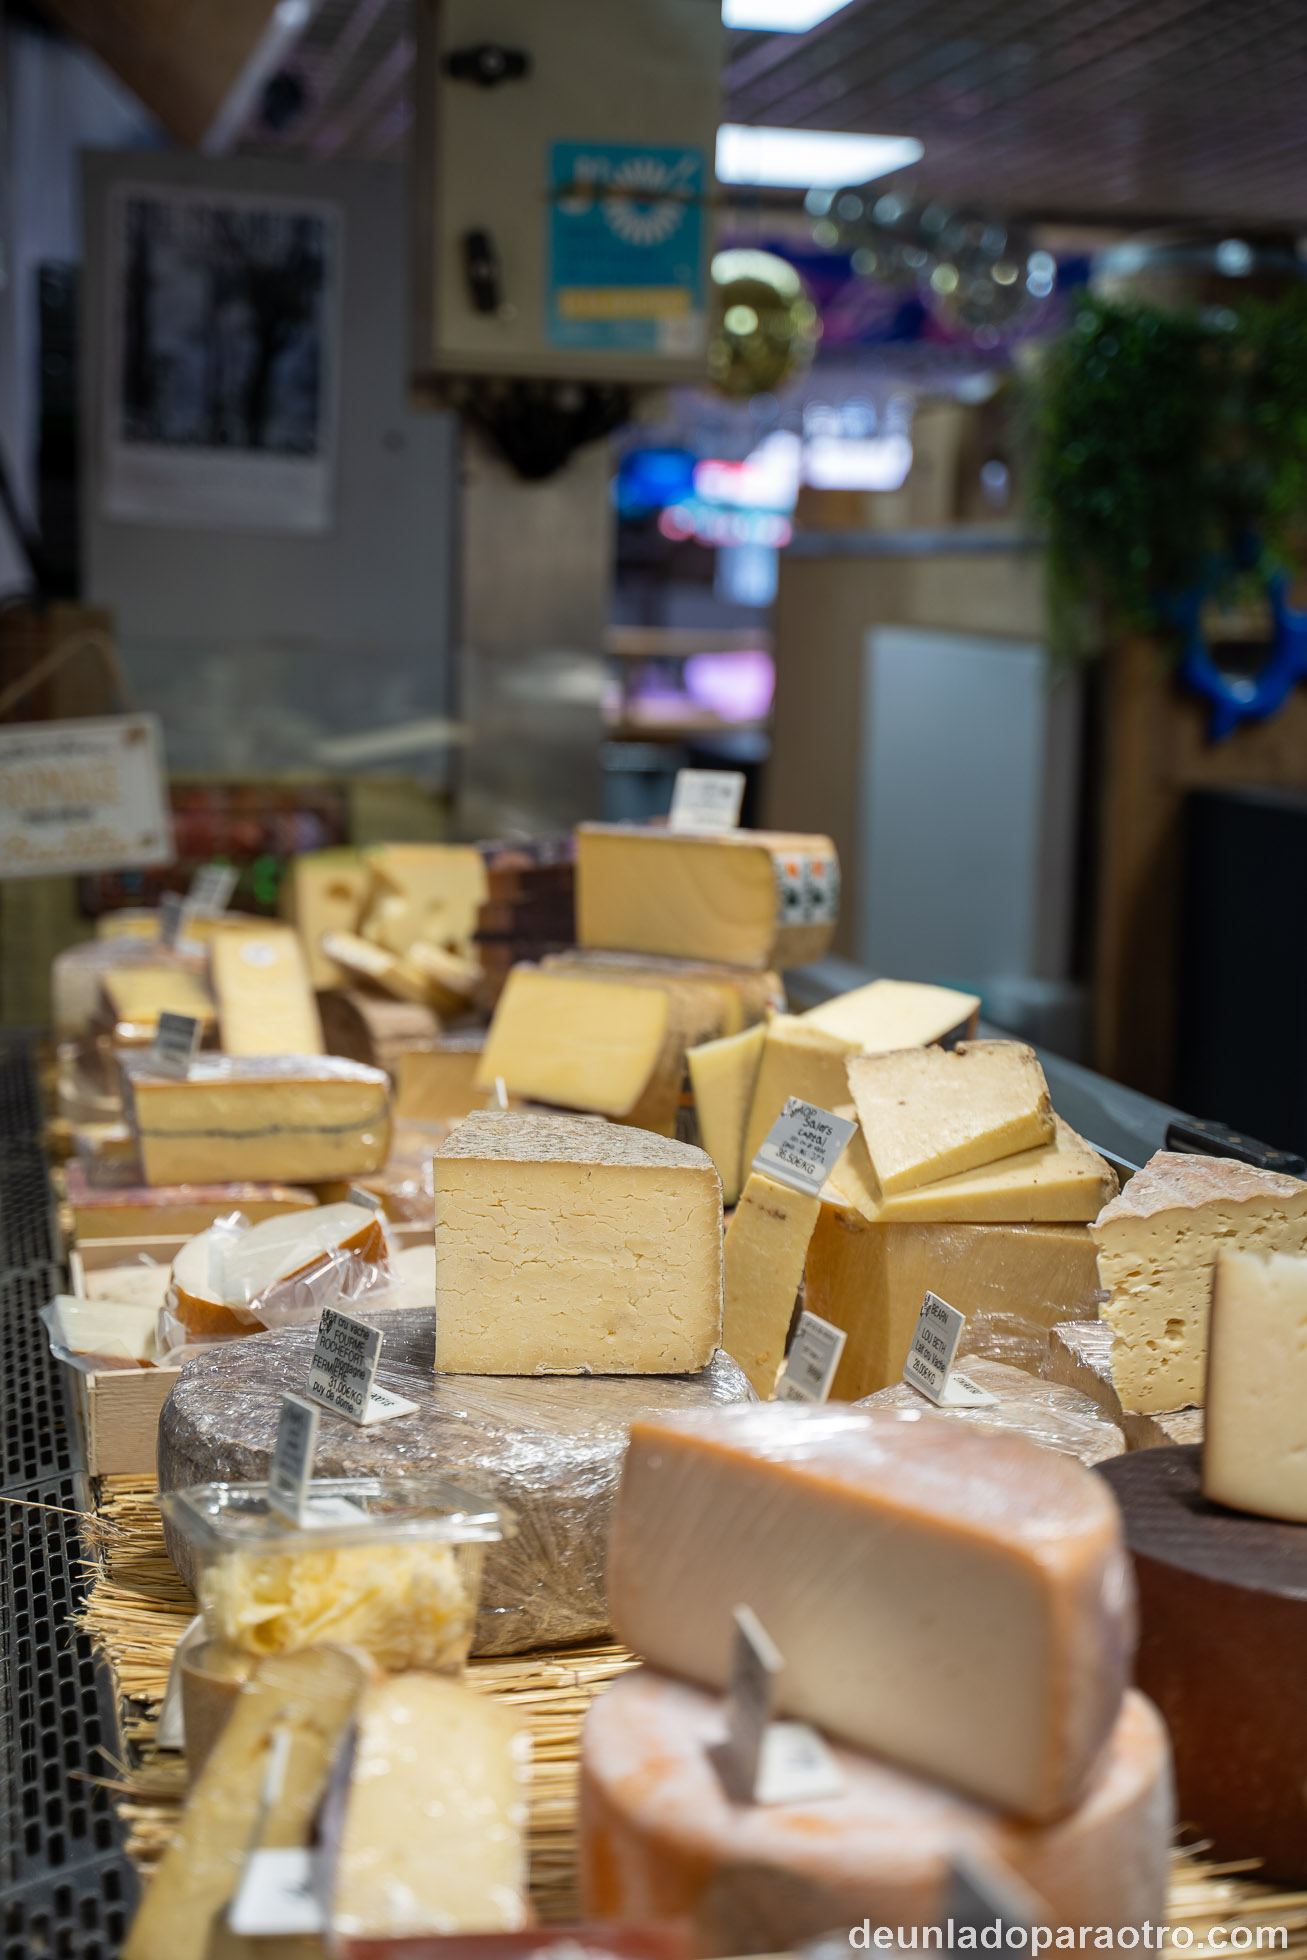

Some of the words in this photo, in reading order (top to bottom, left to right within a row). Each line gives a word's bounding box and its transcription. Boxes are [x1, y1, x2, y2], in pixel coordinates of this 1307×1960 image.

[931, 1304, 948, 1324] BEARN
[338, 1318, 349, 1330] cru
[350, 1324, 370, 1341] vache
[320, 1336, 364, 1365] ROCHEFORT
[334, 1331, 365, 1353] FOURME
[312, 1381, 326, 1396] puy
[326, 1388, 335, 1401] de
